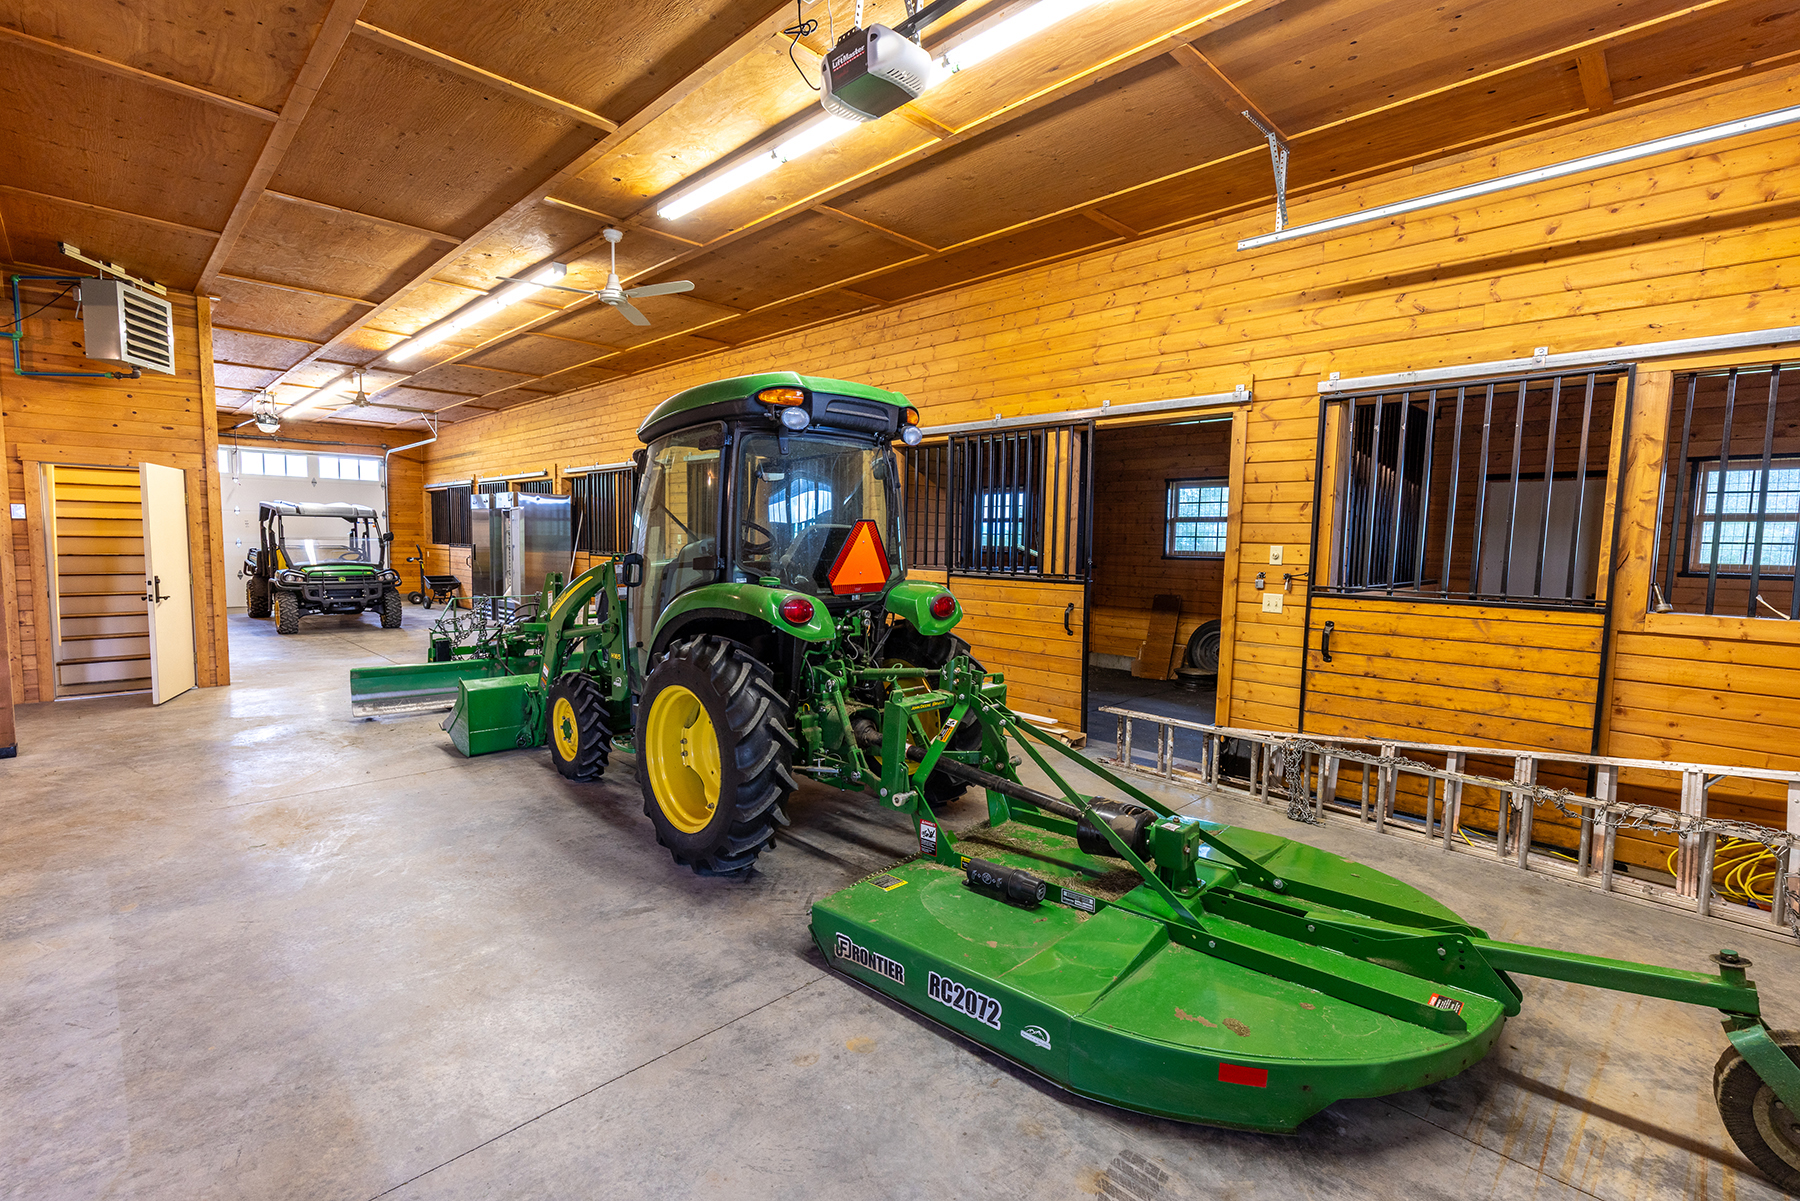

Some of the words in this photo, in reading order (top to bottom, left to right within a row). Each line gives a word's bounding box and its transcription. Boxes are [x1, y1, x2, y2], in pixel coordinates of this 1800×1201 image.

[832, 45, 865, 69] LiftMaster
[835, 932, 905, 985] FRONTIER
[929, 971, 1001, 1029] RC2072
